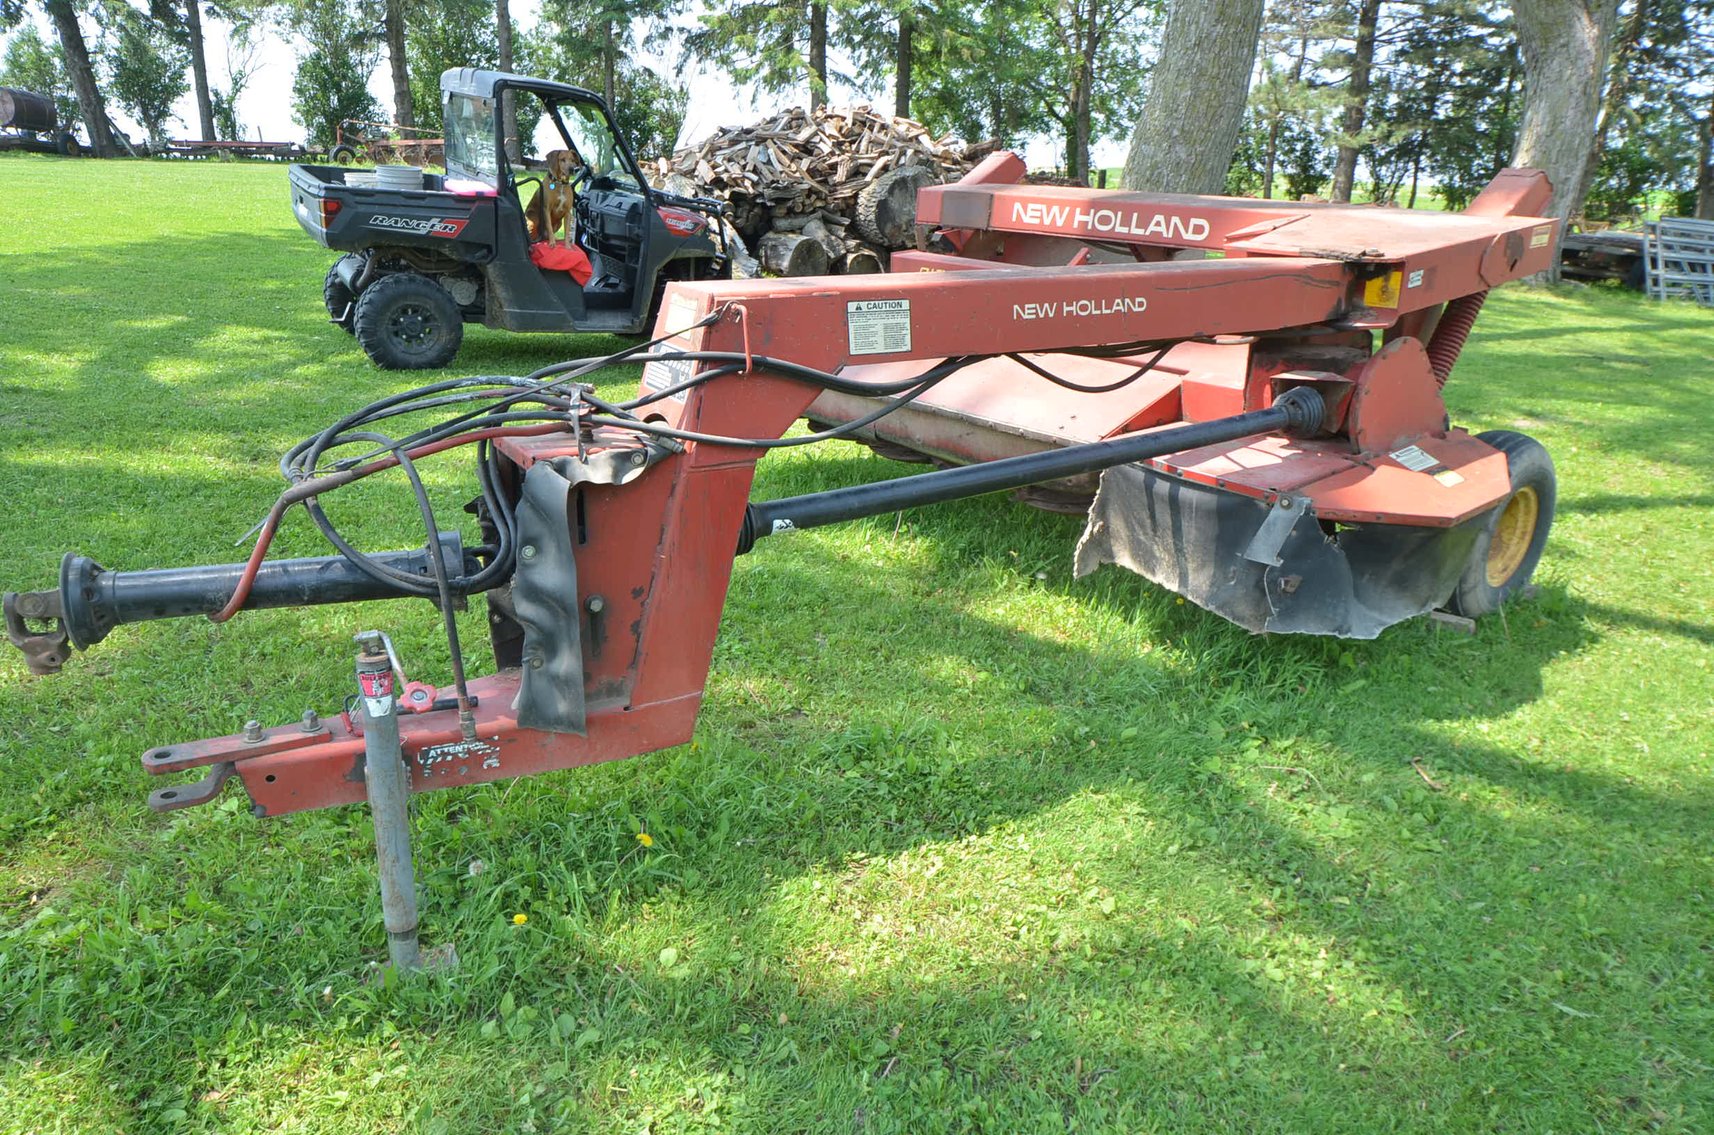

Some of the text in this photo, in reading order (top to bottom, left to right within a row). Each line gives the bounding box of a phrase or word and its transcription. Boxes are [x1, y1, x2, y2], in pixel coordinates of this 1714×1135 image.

[369, 215, 458, 234] RANGER
[1011, 201, 1211, 242] NEW HOLLAND
[866, 301, 903, 310] CAUTION
[1013, 297, 1148, 320] NEW HOLLAND
[428, 742, 491, 757] ATTENTO
